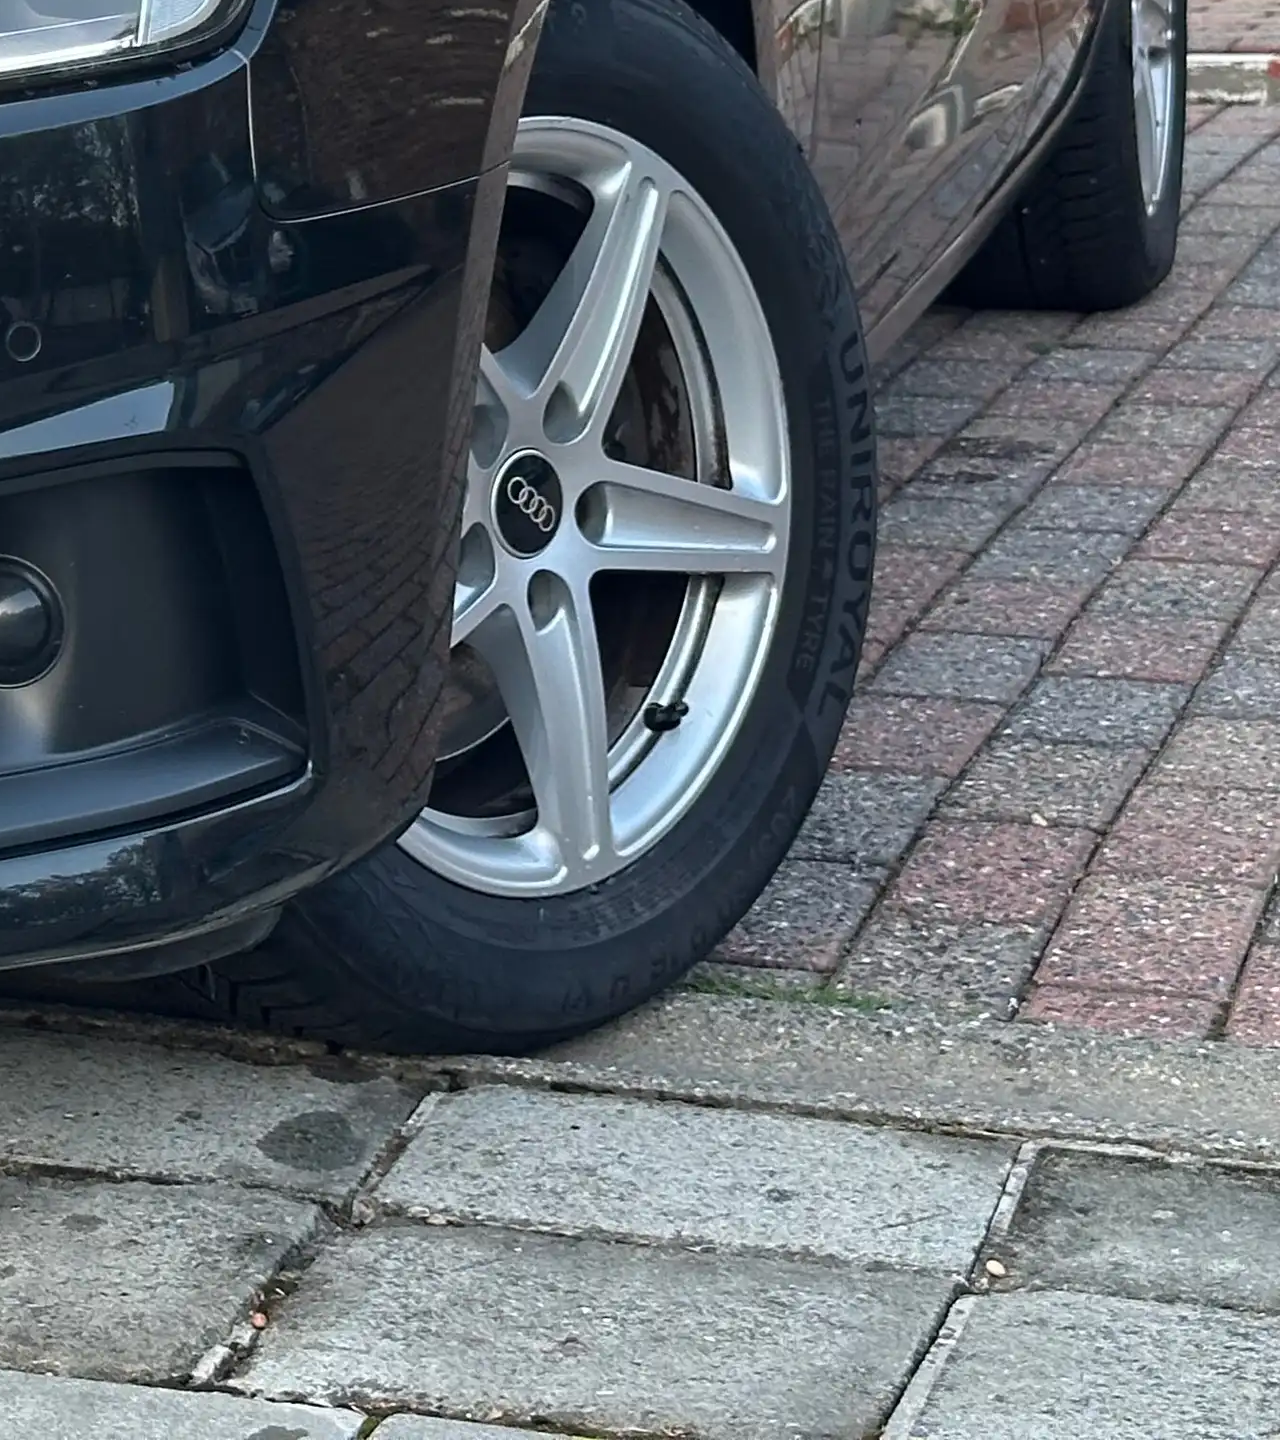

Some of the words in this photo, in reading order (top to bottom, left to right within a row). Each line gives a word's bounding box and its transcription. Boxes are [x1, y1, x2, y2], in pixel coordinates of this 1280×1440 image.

[813, 397, 836, 456] THE
[817, 468, 840, 551] RAIN
[817, 330, 873, 720] UNIROYAL
[794, 592, 831, 674] TYRE
